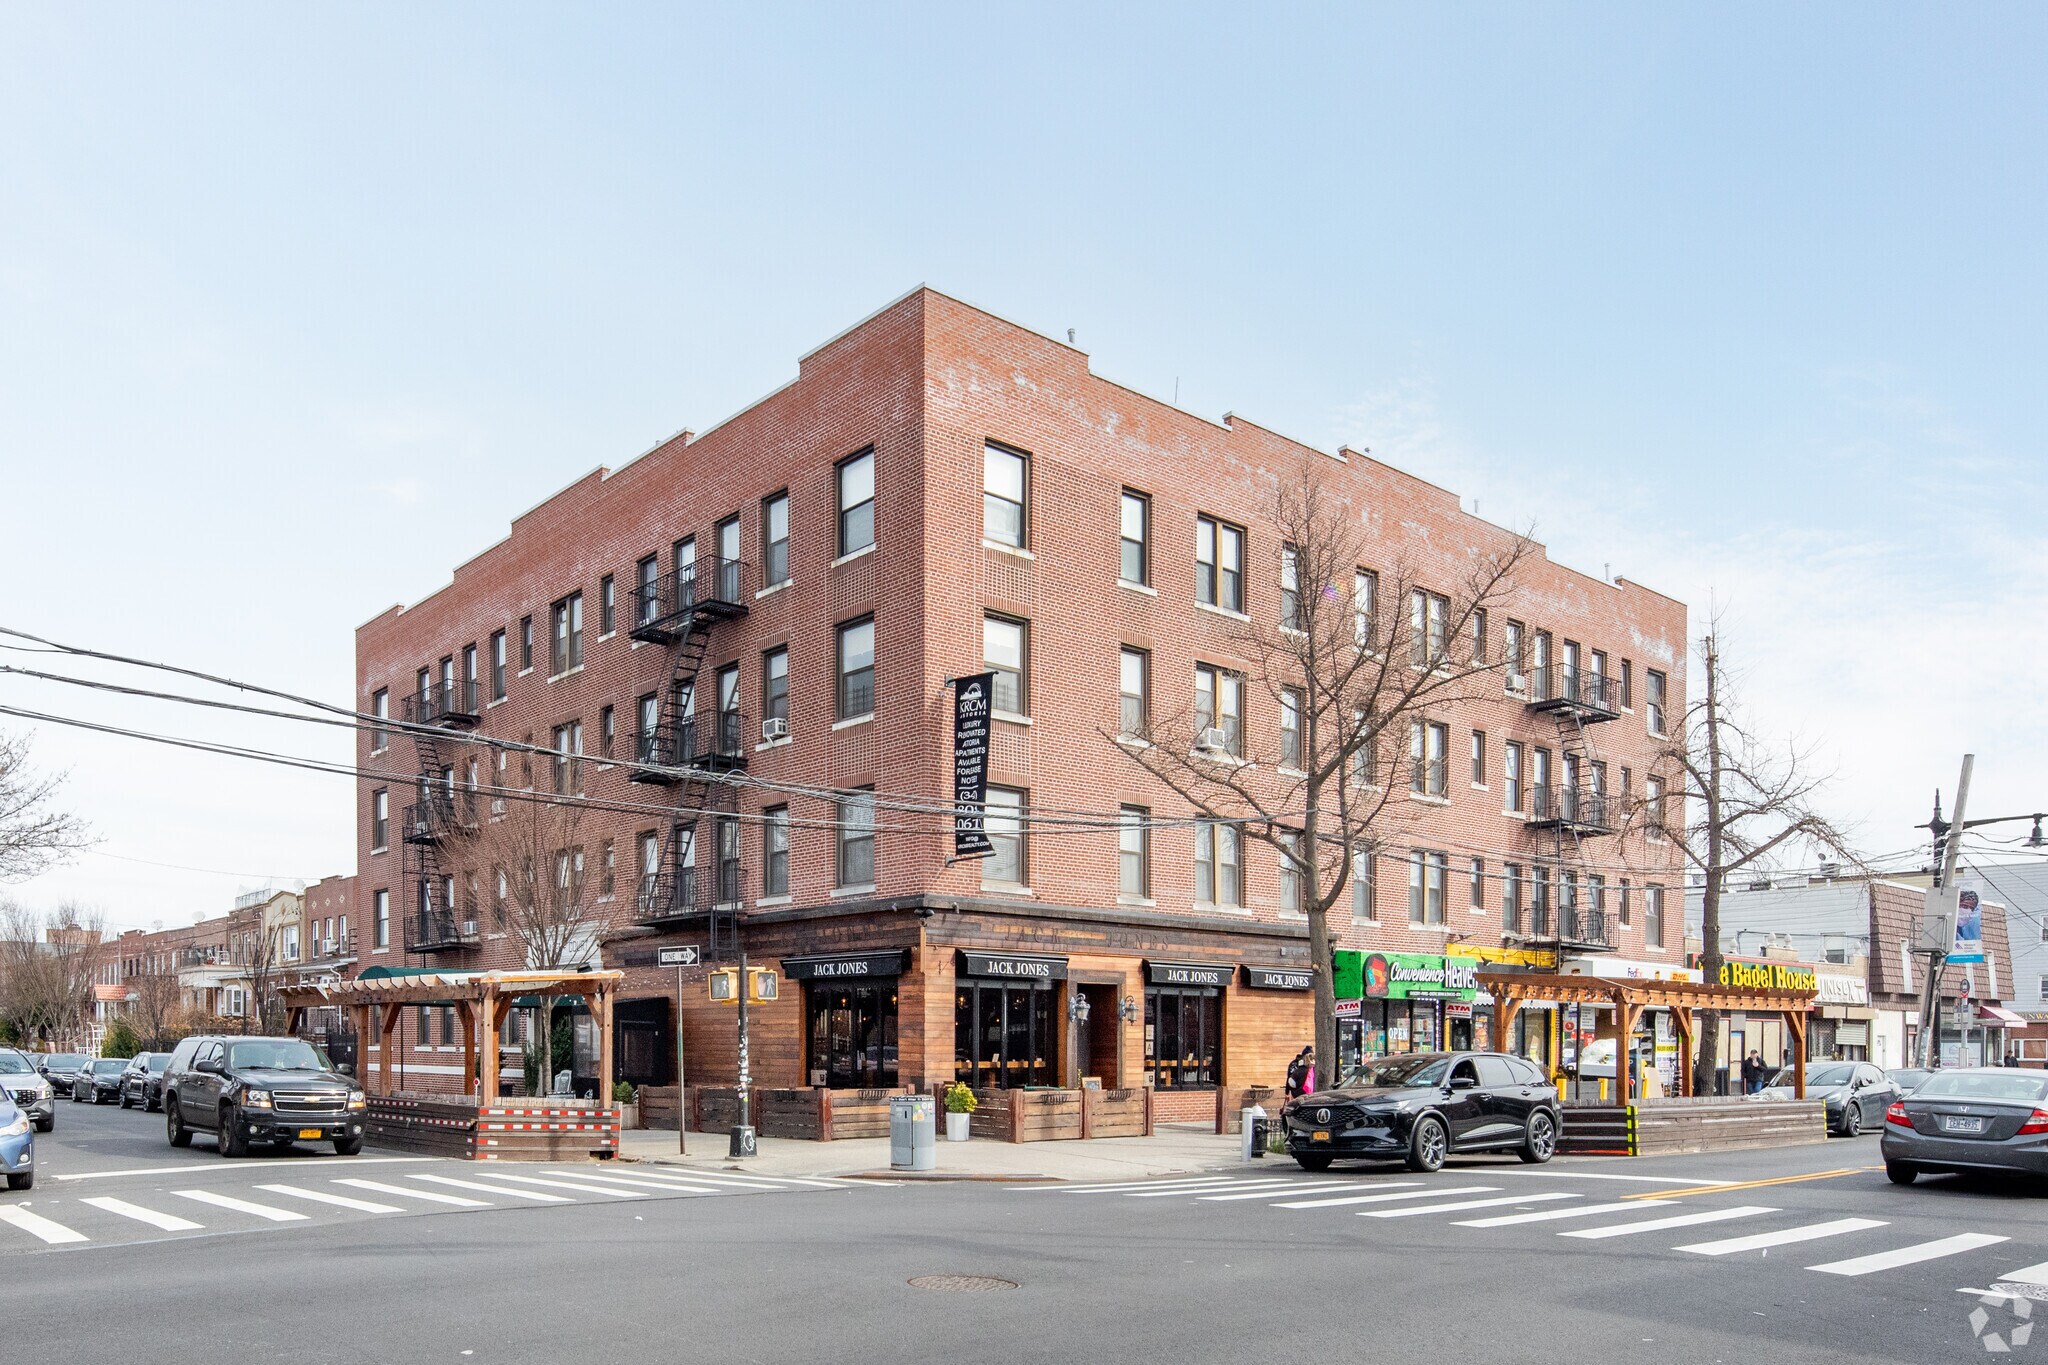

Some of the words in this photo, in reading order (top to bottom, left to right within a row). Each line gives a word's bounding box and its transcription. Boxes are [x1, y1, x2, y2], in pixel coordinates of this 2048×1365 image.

[960, 699, 987, 713] KRCM
[664, 953, 676, 961] ONE
[680, 952, 693, 960] WAY
[813, 963, 836, 976] JACK
[836, 961, 868, 975] JONES
[987, 961, 1014, 975] JACK
[1015, 962, 1050, 976] JONES
[1390, 961, 1445, 982] Convenience
[1445, 959, 1478, 989] Heaven
[1627, 967, 1643, 978] FedEx
[1167, 969, 1189, 982] JACK
[1190, 971, 1218, 984] JONES
[1264, 973, 1284, 985] JACK
[1284, 974, 1309, 987] JONES
[1733, 962, 1774, 988] Bagel
[1775, 964, 1817, 990] House
[1336, 1002, 1359, 1010] ATM
[1447, 1004, 1470, 1012] ATM
[1388, 1027, 1409, 1040] OPEN
